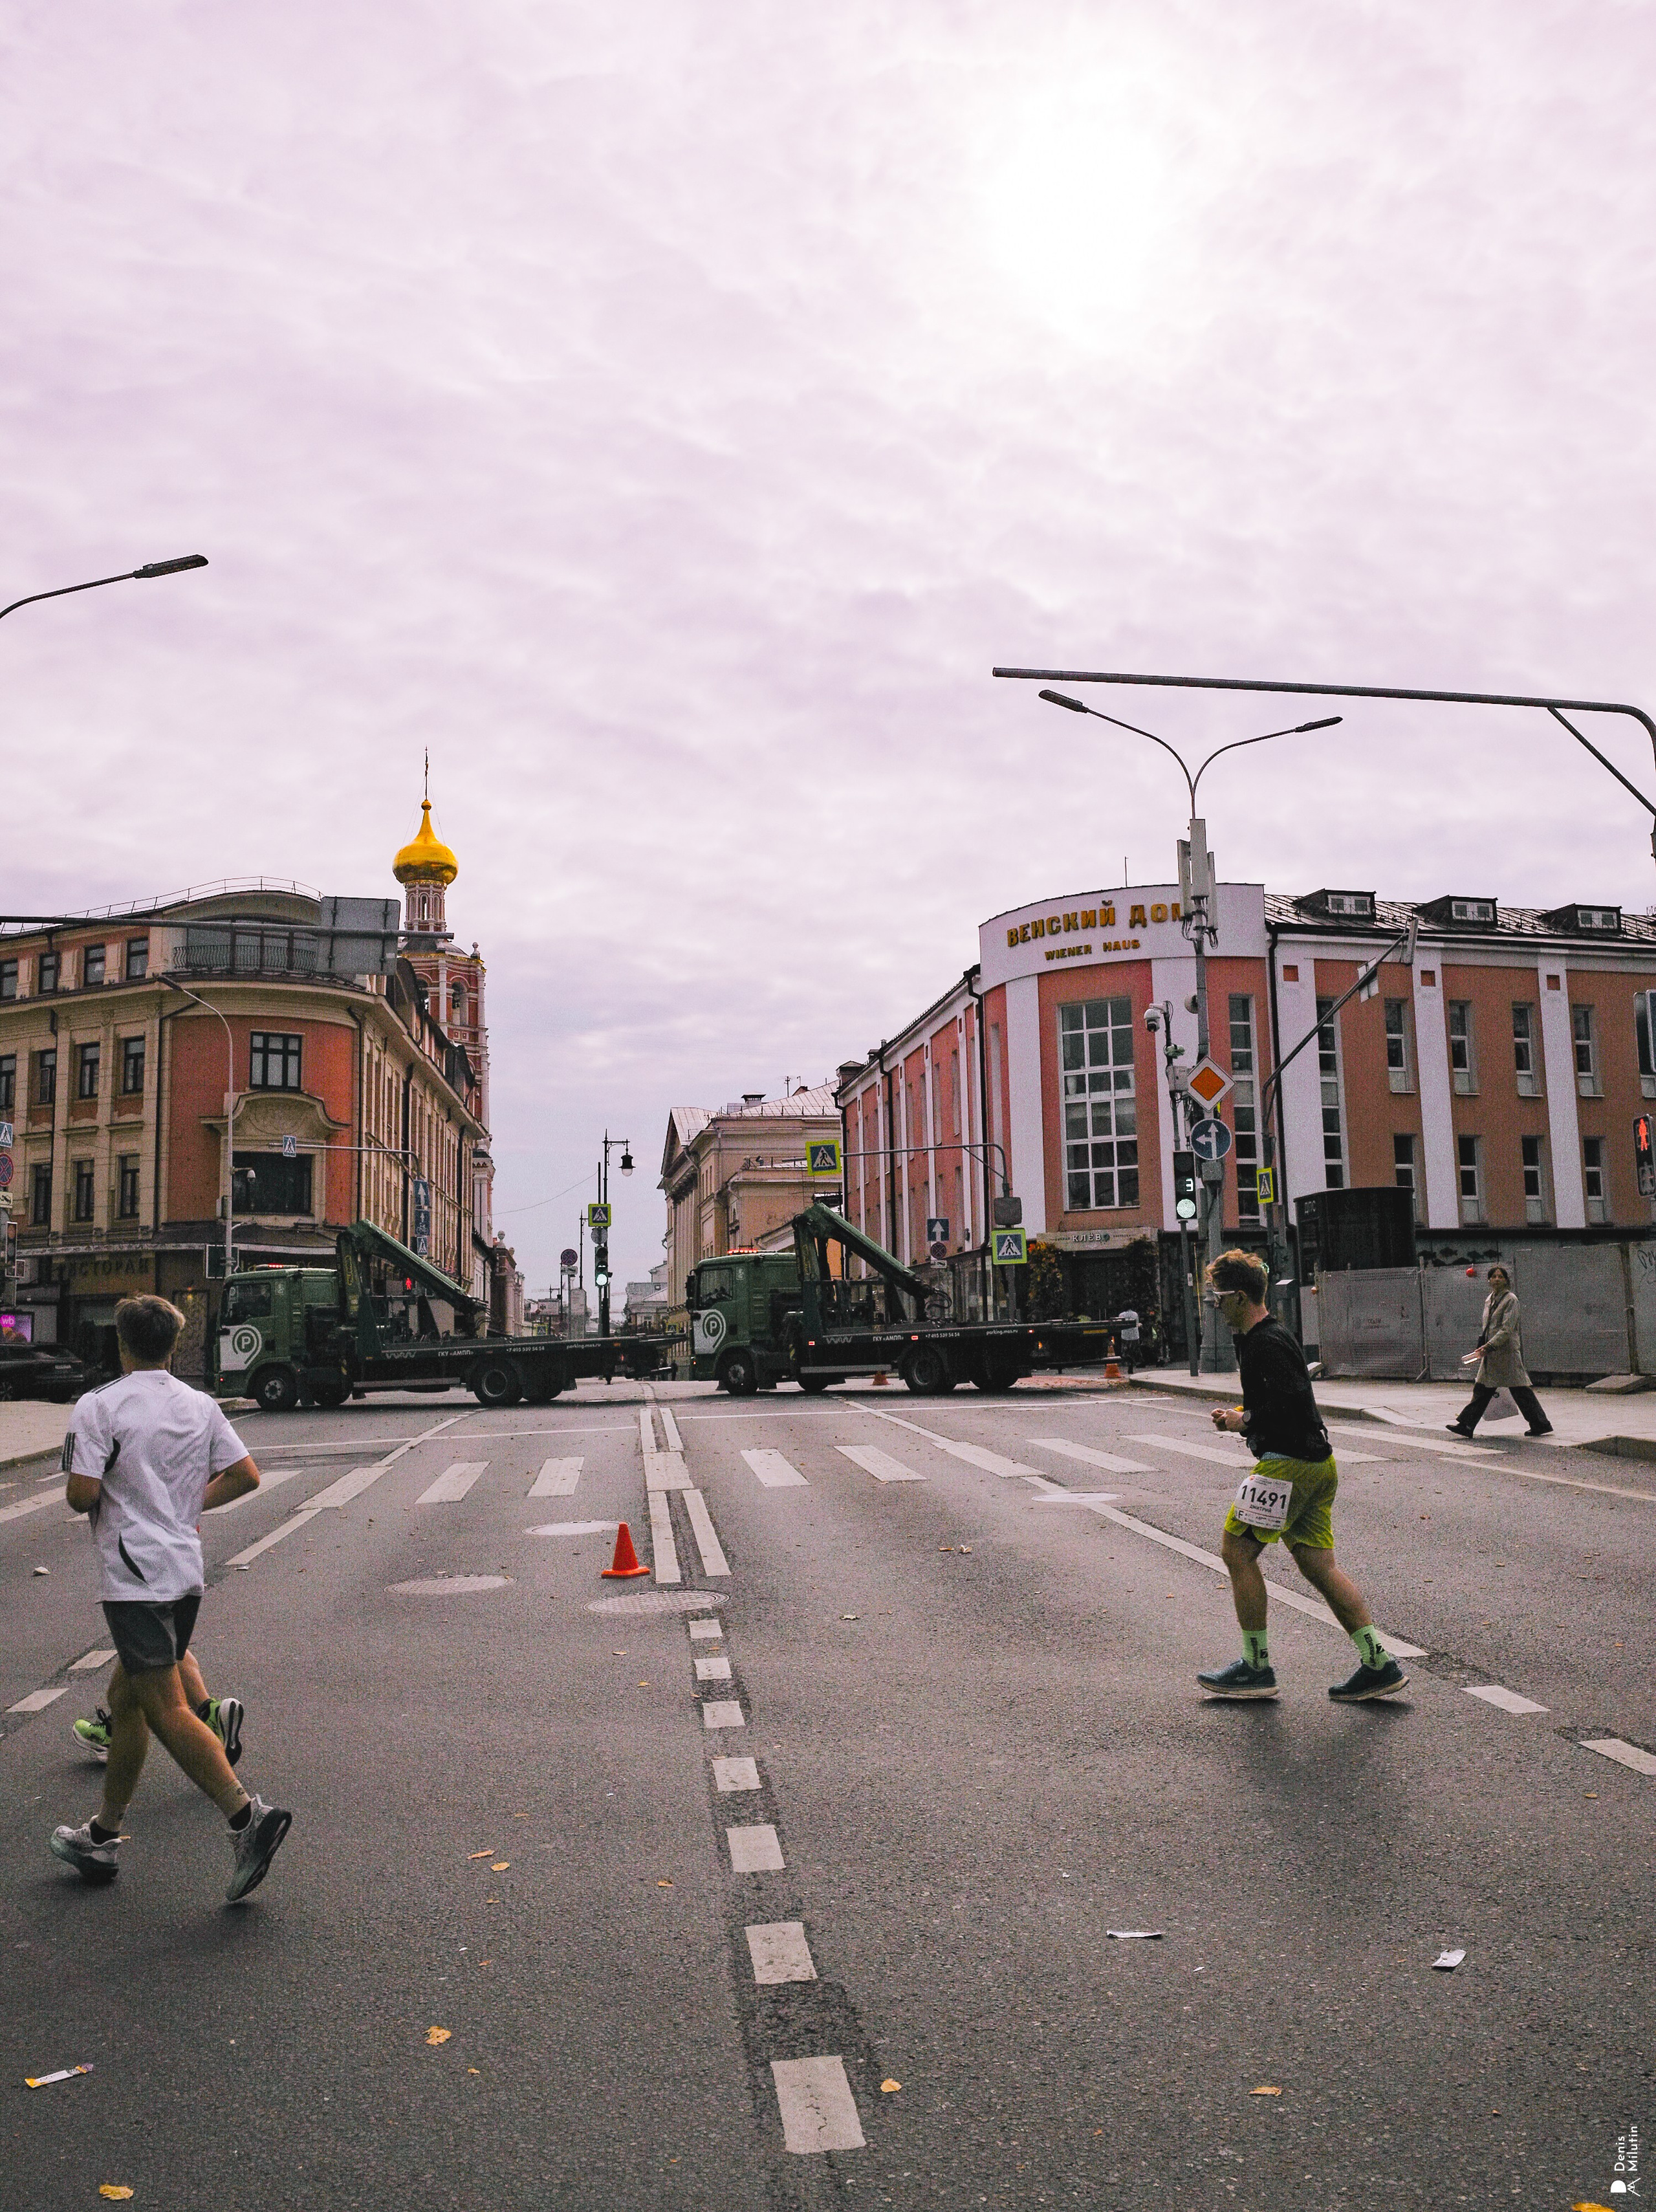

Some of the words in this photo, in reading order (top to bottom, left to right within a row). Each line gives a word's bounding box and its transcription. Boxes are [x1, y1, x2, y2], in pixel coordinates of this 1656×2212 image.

[1007, 900, 1115, 947] ВЕНСКИЙ
[1044, 944, 1092, 961] WIENER
[1102, 939, 1140, 952] HAUS
[1185, 1177, 1194, 1192] 3
[1241, 1485, 1287, 1509] 11491
[1238, 1510, 1244, 1518] F
[1249, 1504, 1272, 1513] ДМИТРИЙ
